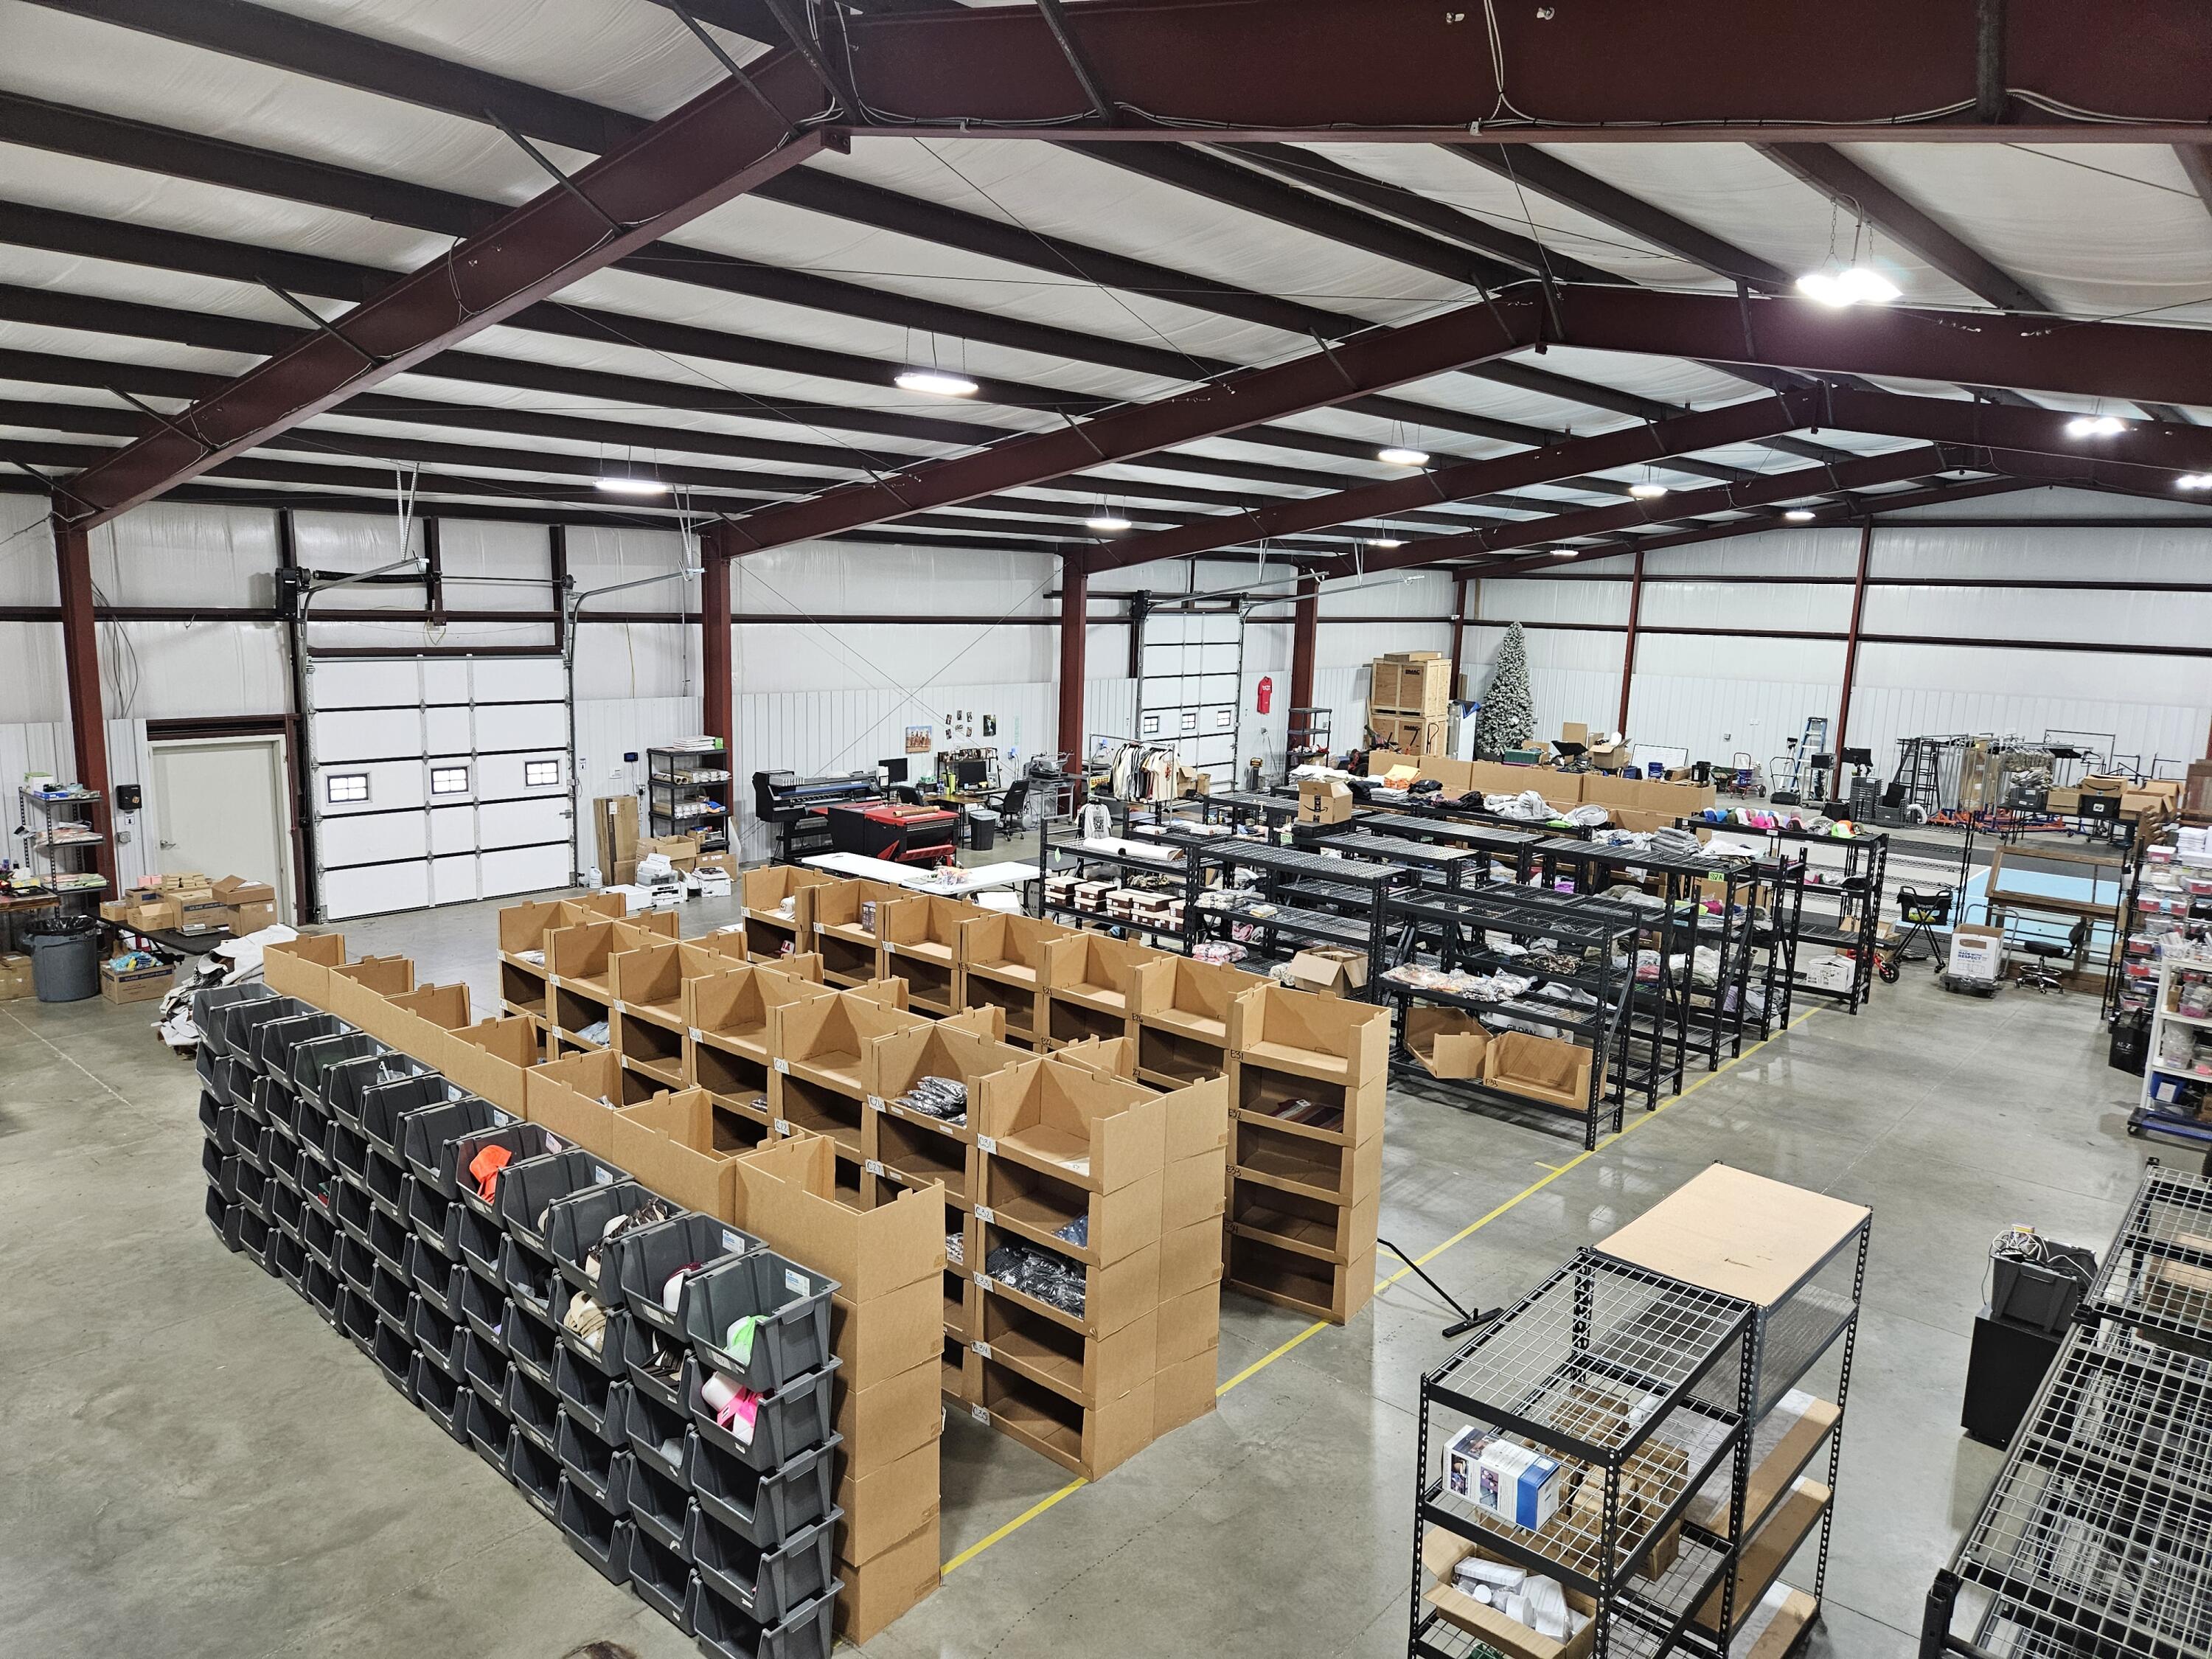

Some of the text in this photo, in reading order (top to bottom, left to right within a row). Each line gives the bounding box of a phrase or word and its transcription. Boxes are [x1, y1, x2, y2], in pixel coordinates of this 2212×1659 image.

[1043, 986, 1053, 995] E21
[1132, 1012, 1144, 1023] E26
[1230, 1049, 1244, 1060] E31
[775, 1059, 786, 1071] C21
[869, 1096, 883, 1109] C26
[1228, 1108, 1242, 1120] E32
[776, 1120, 788, 1133] C22
[978, 1136, 992, 1149] C31
[867, 1161, 882, 1174] C27
[1226, 1164, 1242, 1178] E33
[975, 1206, 992, 1220] C32
[975, 1274, 990, 1287] C33
[973, 1341, 988, 1354] C34
[973, 1406, 988, 1422] C35
